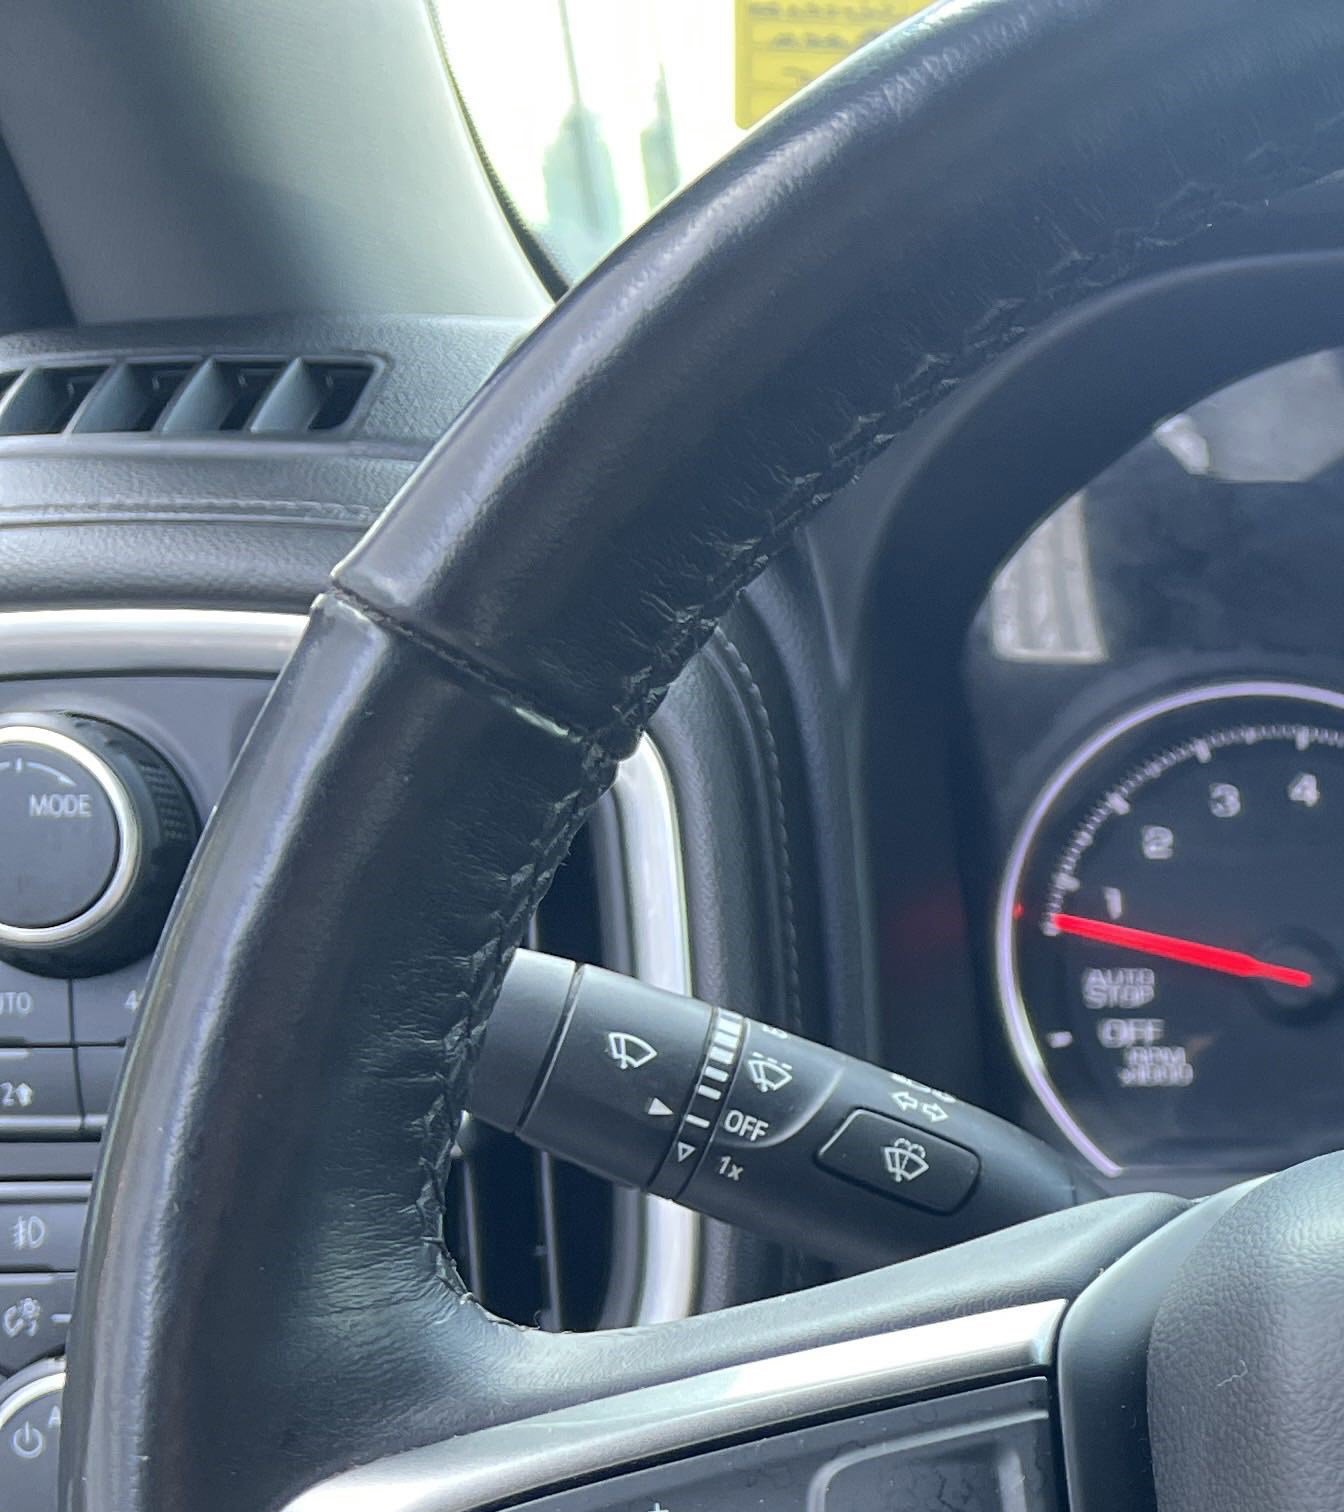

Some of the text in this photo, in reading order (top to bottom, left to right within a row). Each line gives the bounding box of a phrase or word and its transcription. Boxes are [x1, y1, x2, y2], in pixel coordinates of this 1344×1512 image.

[1209, 782, 1242, 818] 3
[1288, 772, 1319, 806] 4
[29, 794, 92, 818] MODE
[1142, 824, 1174, 860] 2
[1104, 886, 1124, 919] 1
[1083, 968, 1154, 985] AUTO
[1083, 985, 1154, 1008] STOP
[1098, 1019, 1164, 1048] OFF
[723, 1107, 769, 1143] OFF
[716, 1154, 745, 1182] 1x
